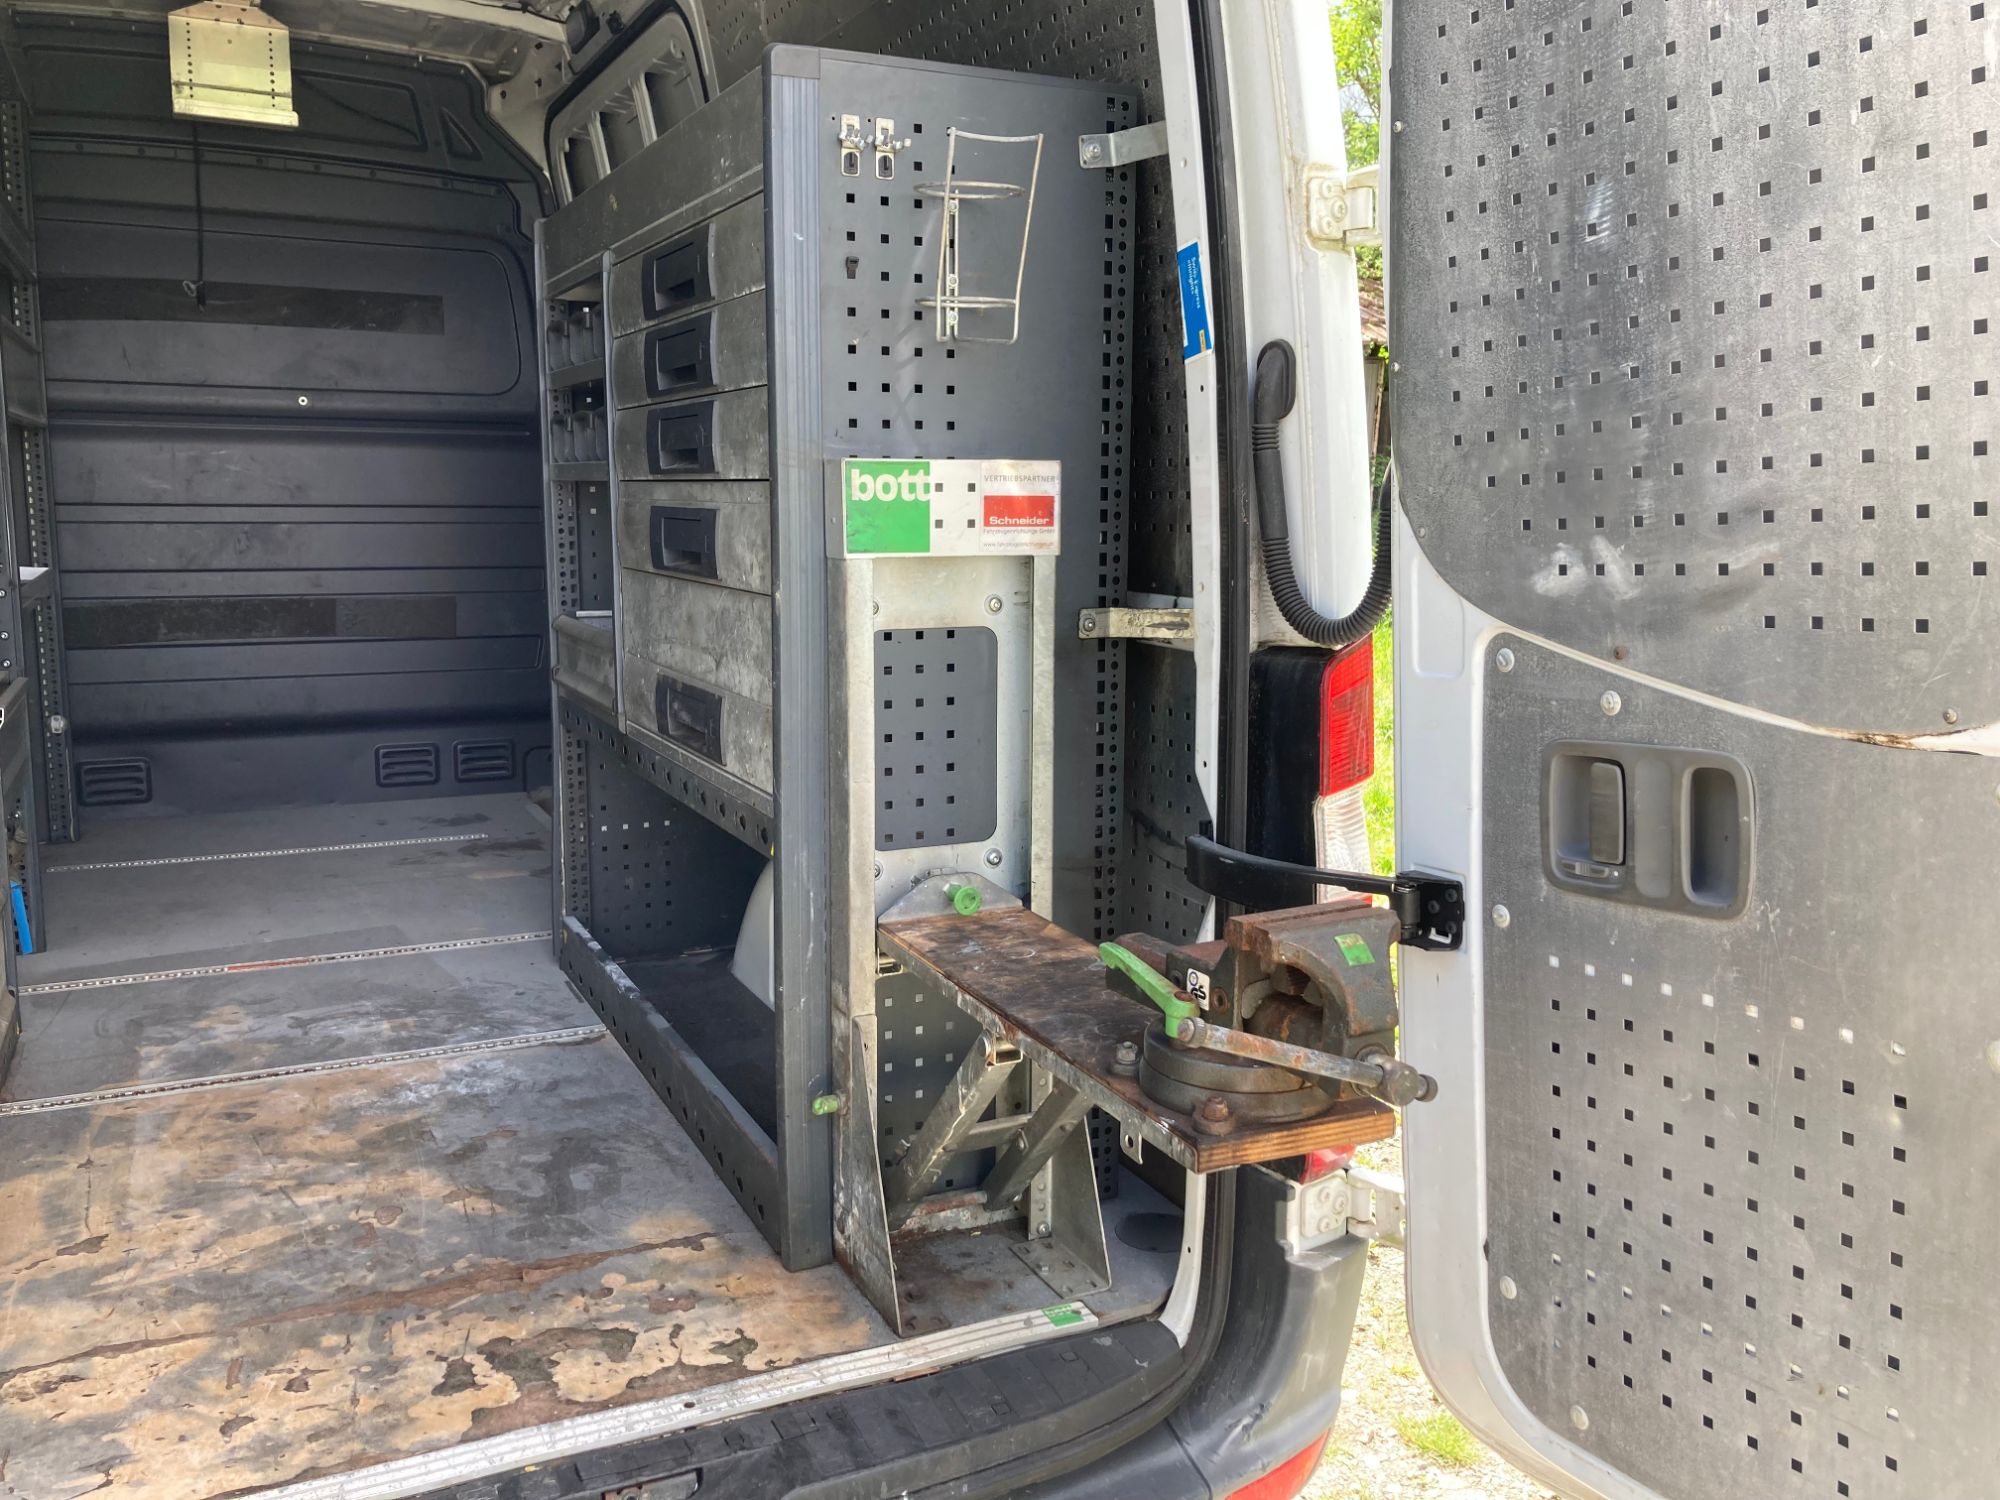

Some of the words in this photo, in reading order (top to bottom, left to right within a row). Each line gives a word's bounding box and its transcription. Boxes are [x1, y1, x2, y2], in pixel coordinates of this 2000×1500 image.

[984, 474, 1056, 482] VERTRIEBSPARTNER
[851, 468, 931, 502] bott
[989, 516, 1050, 525] Schneider
